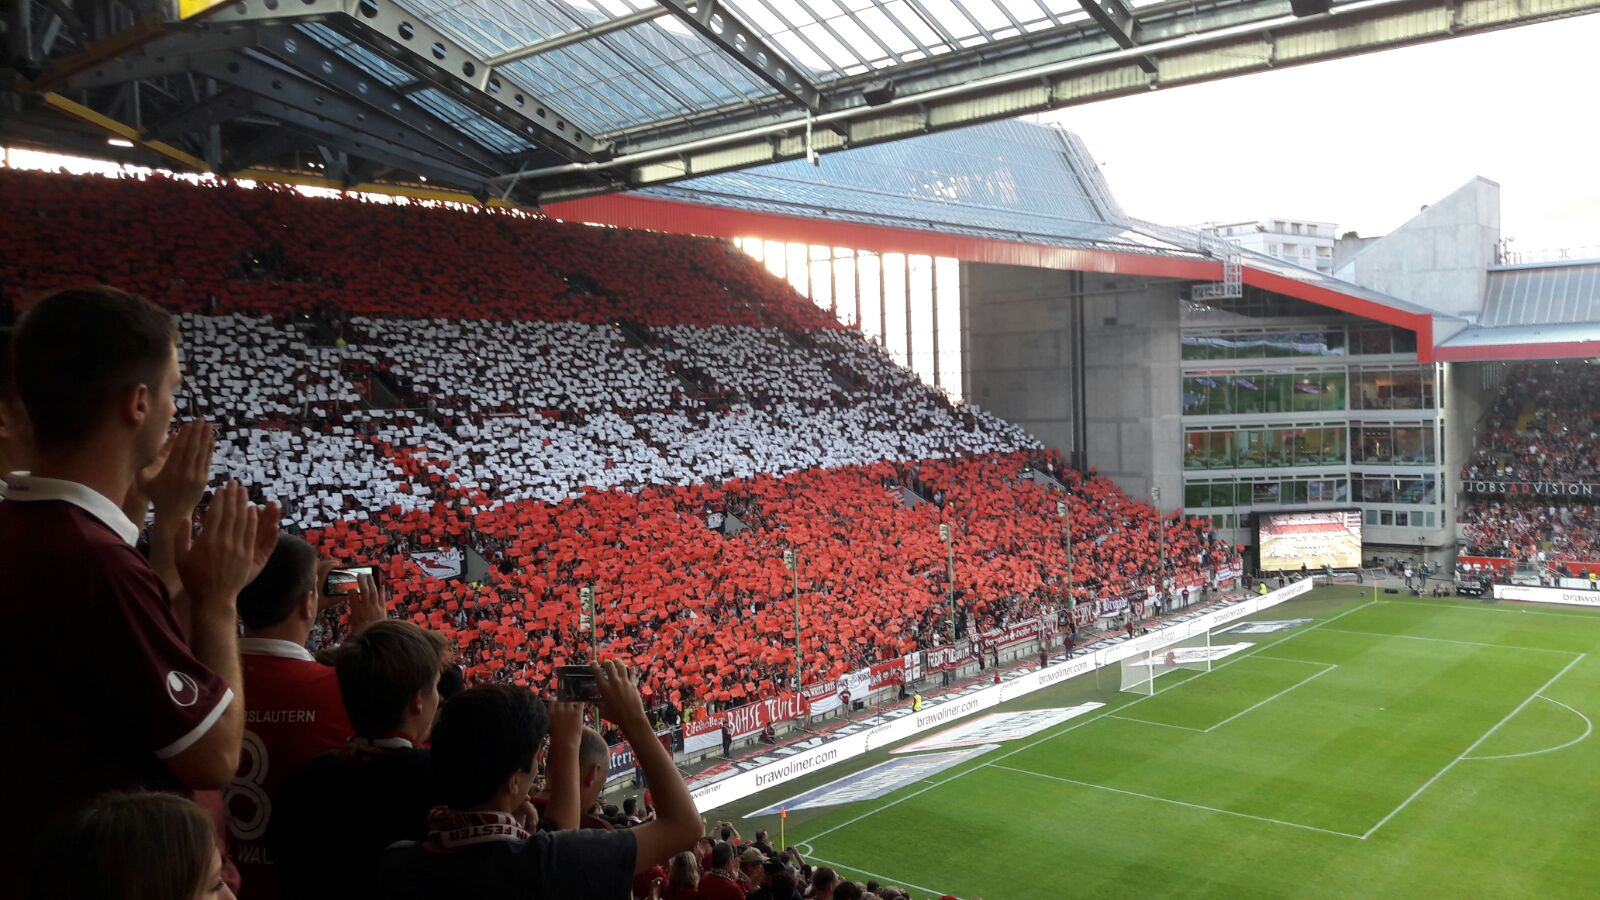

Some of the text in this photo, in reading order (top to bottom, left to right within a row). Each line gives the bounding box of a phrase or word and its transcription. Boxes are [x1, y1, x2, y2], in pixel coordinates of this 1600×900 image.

[1038, 662, 1088, 685] brawoliner.com
[246, 710, 316, 723] SLAUTERN
[917, 699, 978, 728] brawoliner.com
[755, 748, 837, 787] brawoliner.com
[224, 729, 272, 840] 8
[691, 784, 722, 800] woliner
[238, 845, 278, 865] WAL
